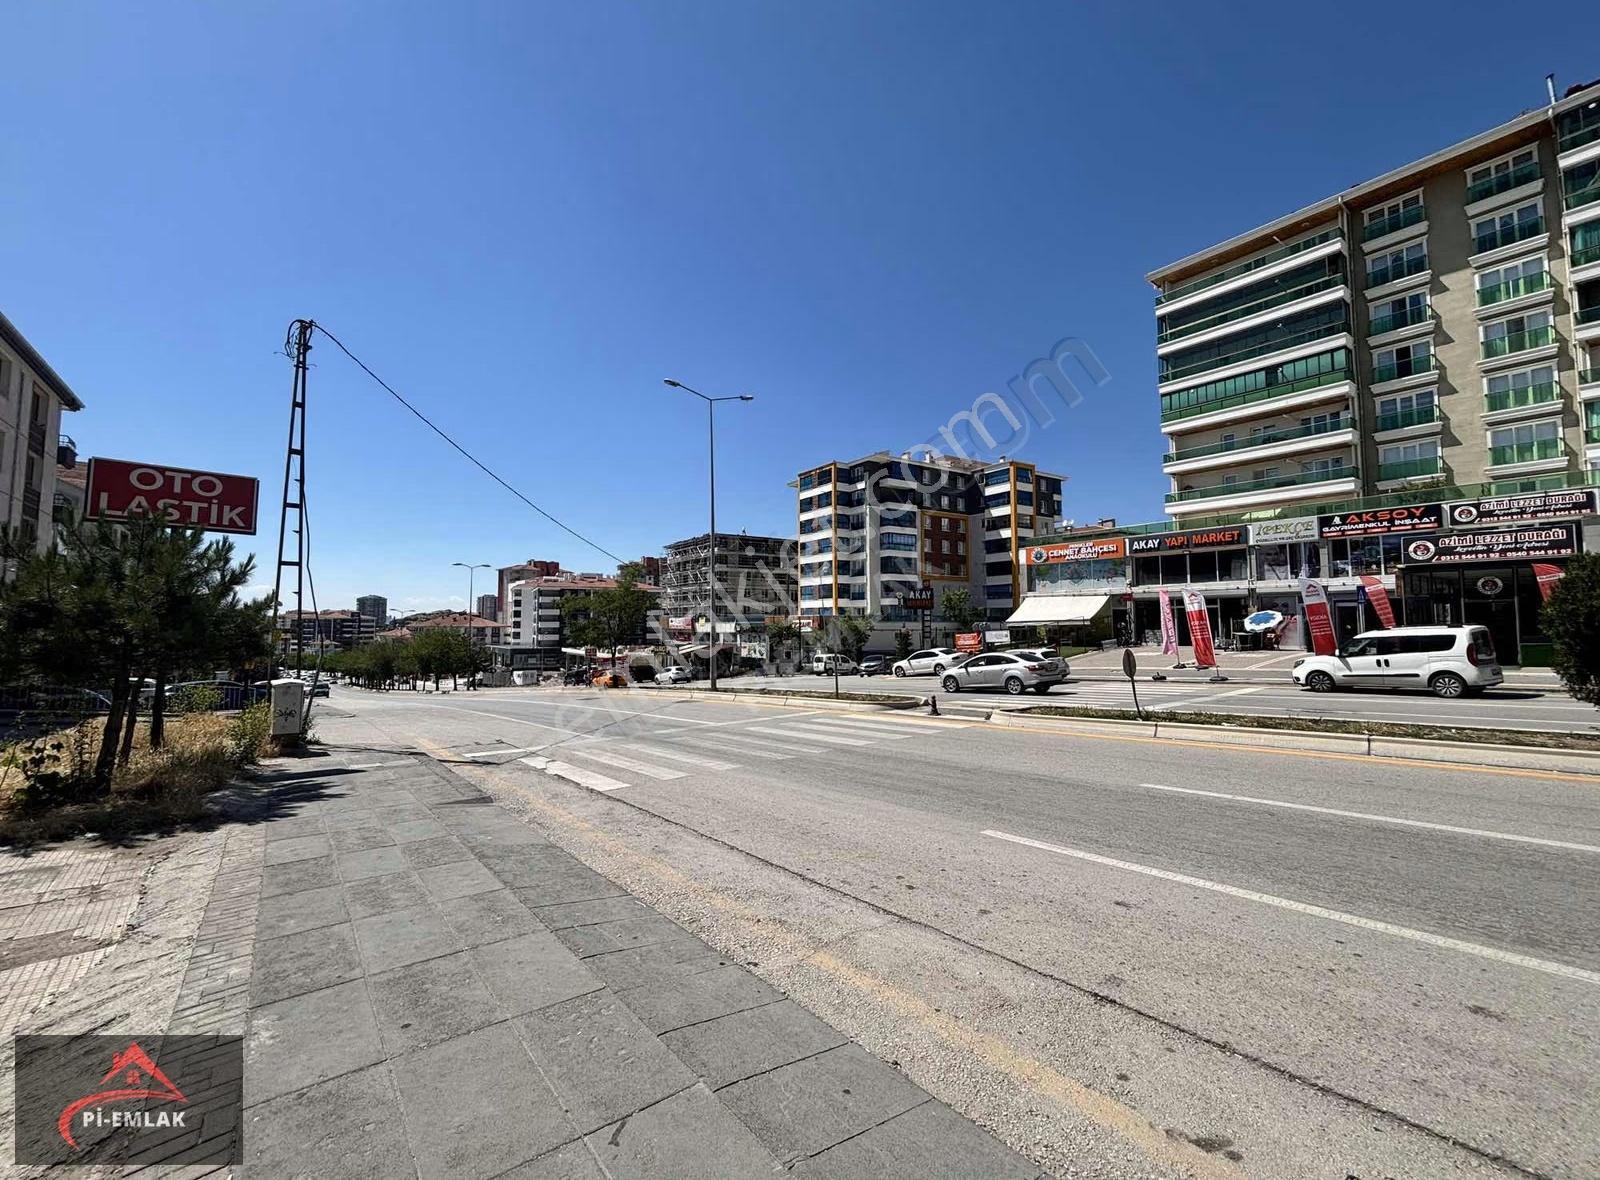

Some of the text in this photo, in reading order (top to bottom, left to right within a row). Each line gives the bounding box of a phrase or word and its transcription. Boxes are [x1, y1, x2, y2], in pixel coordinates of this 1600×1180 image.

[129, 468, 223, 498] OTO
[1510, 497, 1545, 509] LEZZET
[1545, 493, 1587, 506] DURAĞI
[100, 491, 247, 528] LASTİK
[1346, 508, 1426, 524] AKSOY
[1322, 521, 1391, 533] GAYRİMENKUL
[1132, 537, 1161, 551] AKAY
[1164, 535, 1188, 548] YAPI
[1192, 530, 1241, 545] MARKET
[1439, 528, 1567, 548] AZİMİ LEZZET DURAĞI
[1048, 548, 1081, 557] CENNET
[909, 590, 932, 599] AKAY
